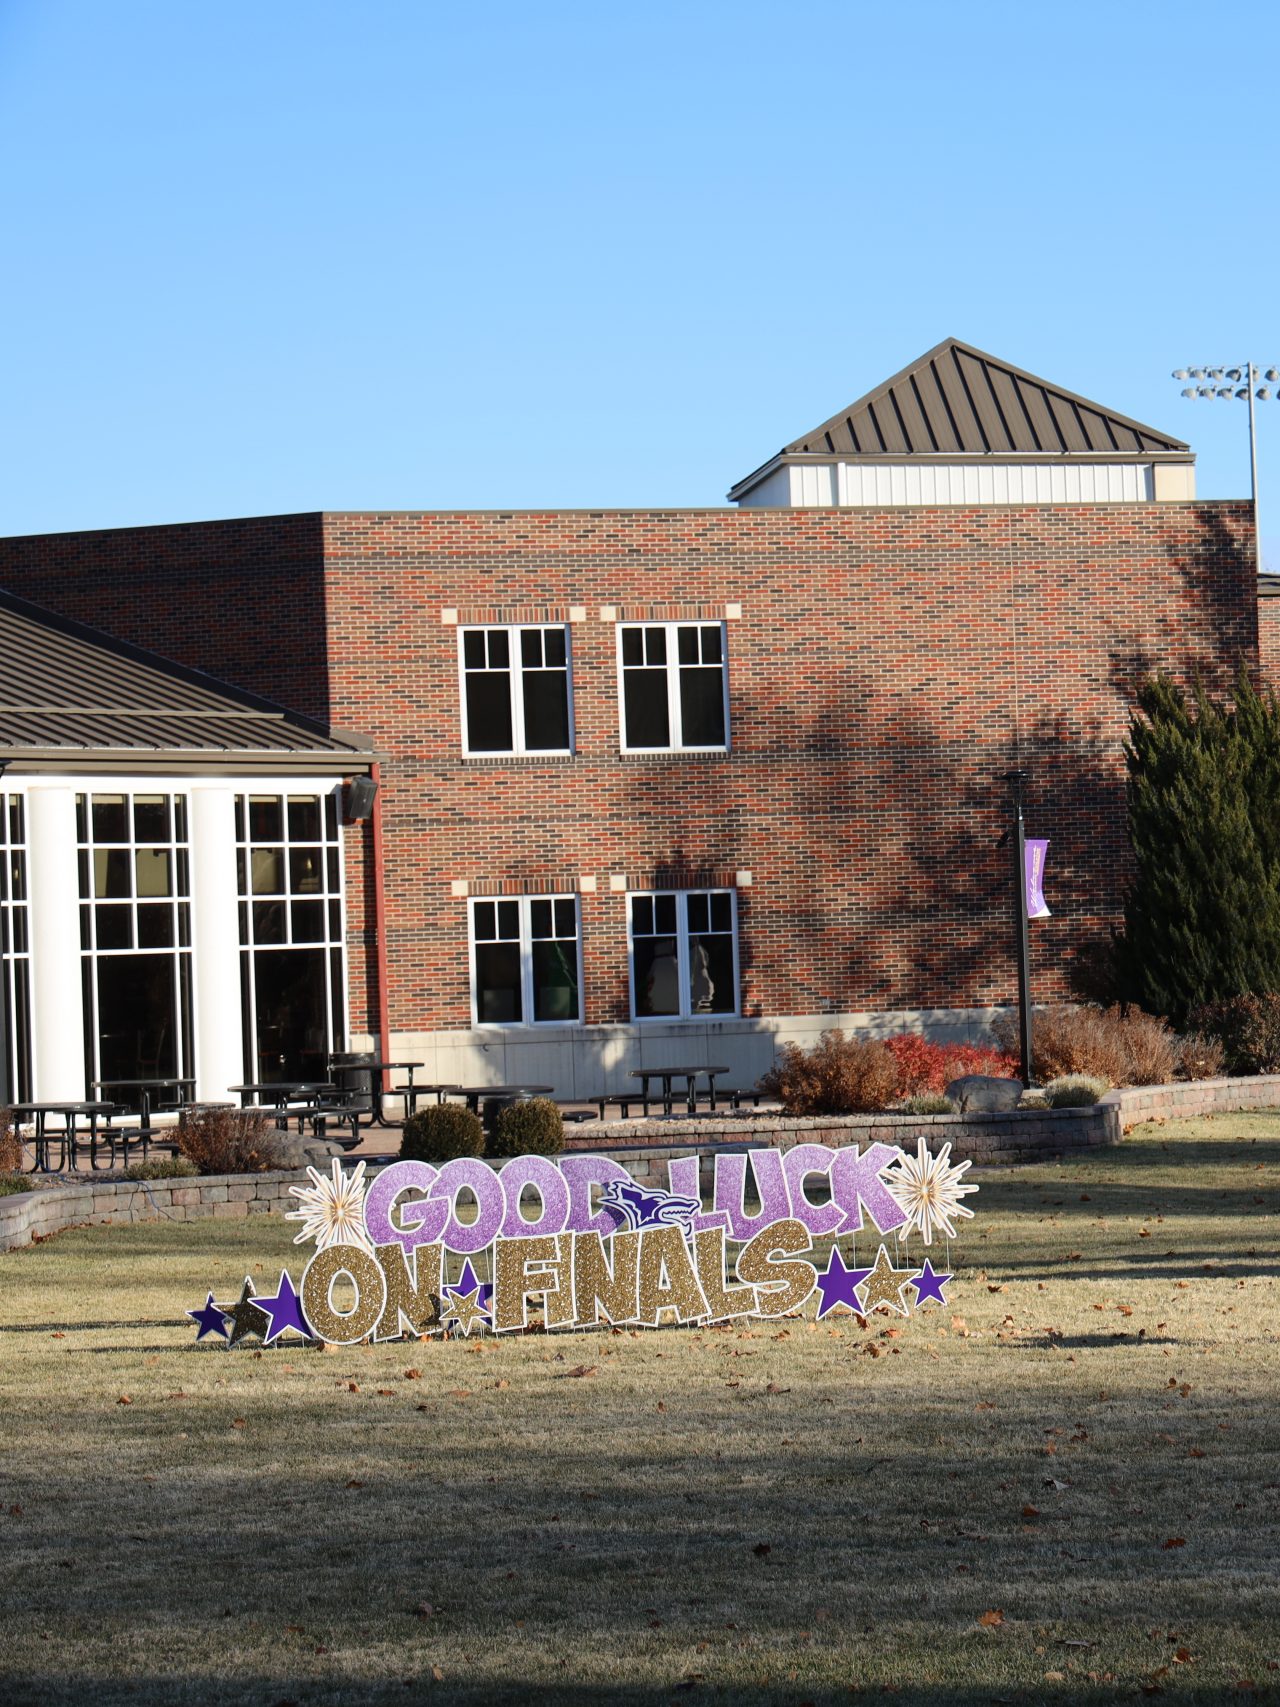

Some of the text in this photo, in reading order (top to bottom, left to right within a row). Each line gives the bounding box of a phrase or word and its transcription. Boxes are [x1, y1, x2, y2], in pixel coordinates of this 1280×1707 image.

[363, 1142, 912, 1254] GOOD LUCK
[301, 1217, 818, 1346] ON FINALS
